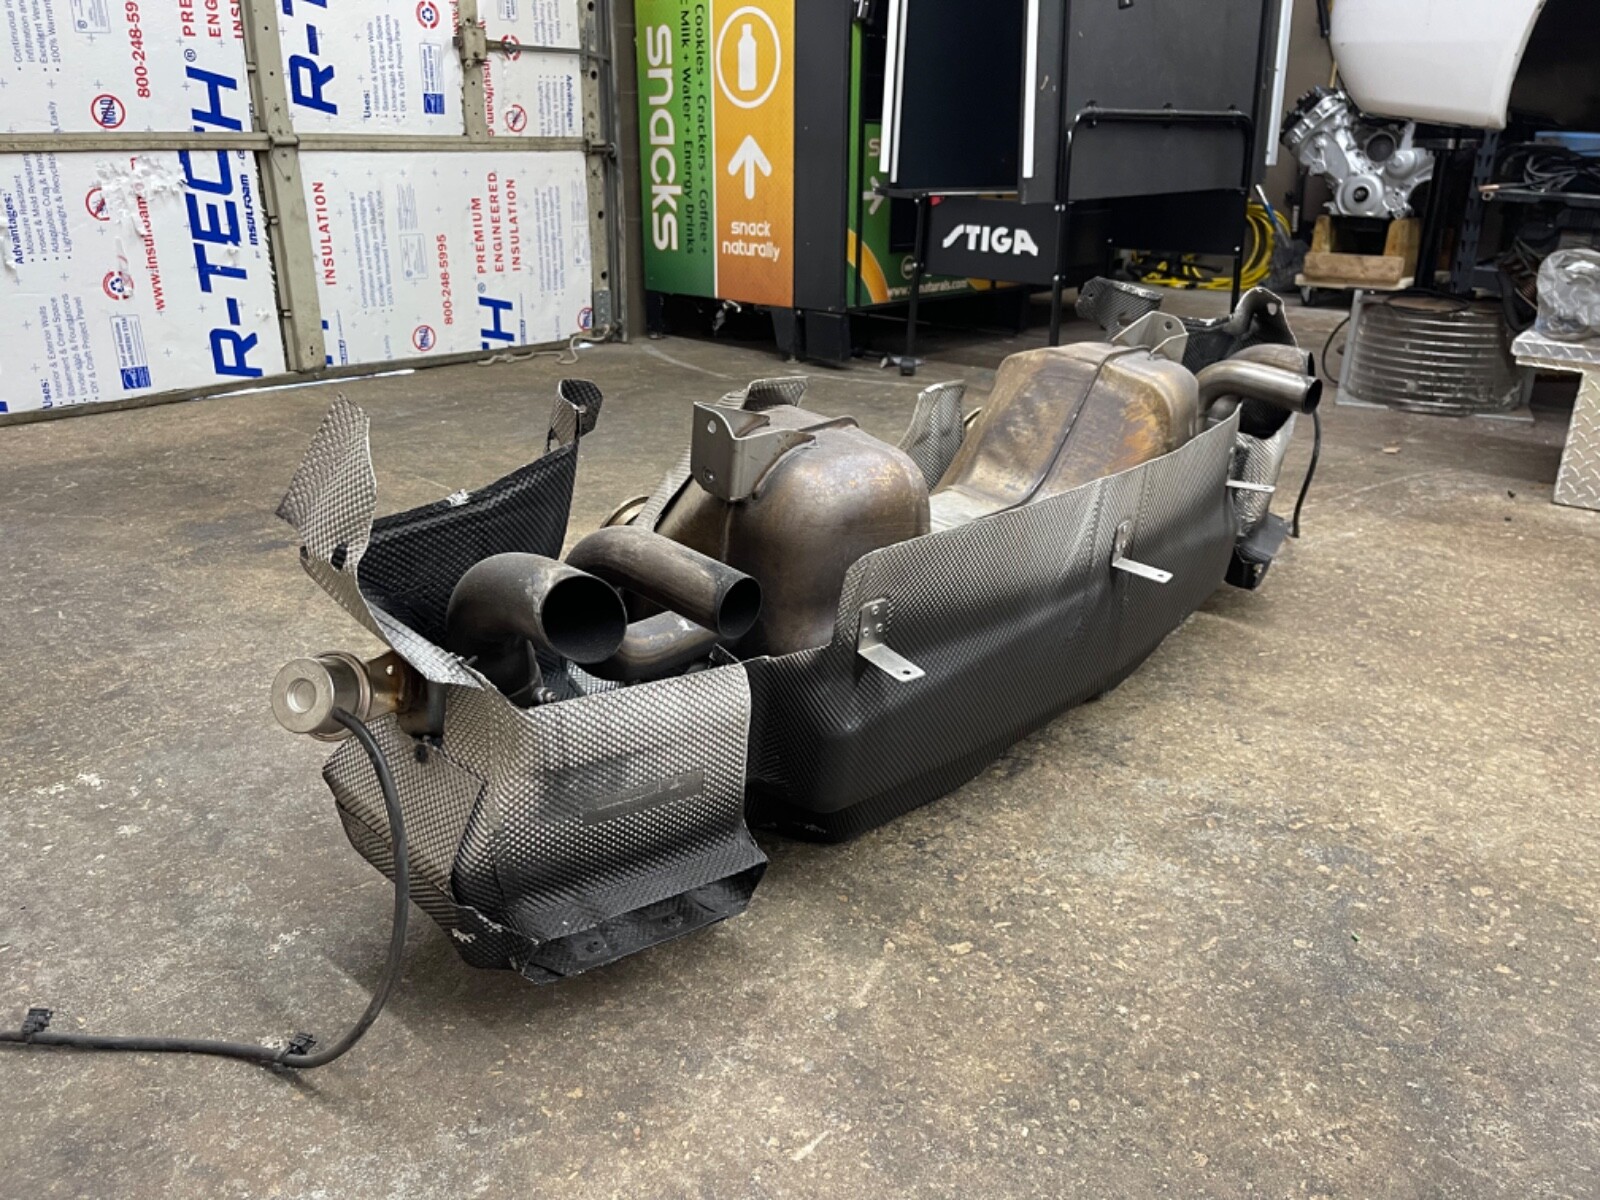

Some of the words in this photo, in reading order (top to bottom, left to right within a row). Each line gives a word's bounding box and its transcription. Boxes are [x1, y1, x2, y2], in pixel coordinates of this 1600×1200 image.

[680, 10, 691, 48] Milk
[695, 4, 706, 75] Cookies
[682, 67, 692, 122] Water
[646, 24, 682, 251] snacks
[696, 94, 708, 171] Crackers
[683, 140, 693, 199] Energy
[312, 181, 337, 287] INSULATION
[471, 198, 487, 274] PREMIUM
[487, 172, 505, 273] ENGINEERED
[506, 179, 521, 272] INSULATION
[685, 204, 695, 254] Drinks
[698, 189, 709, 242] Coffee
[730, 221, 771, 237] snack
[942, 224, 1039, 257] STIGA
[436, 233, 453, 325] 800-248-5995
[722, 239, 781, 262] naturally
